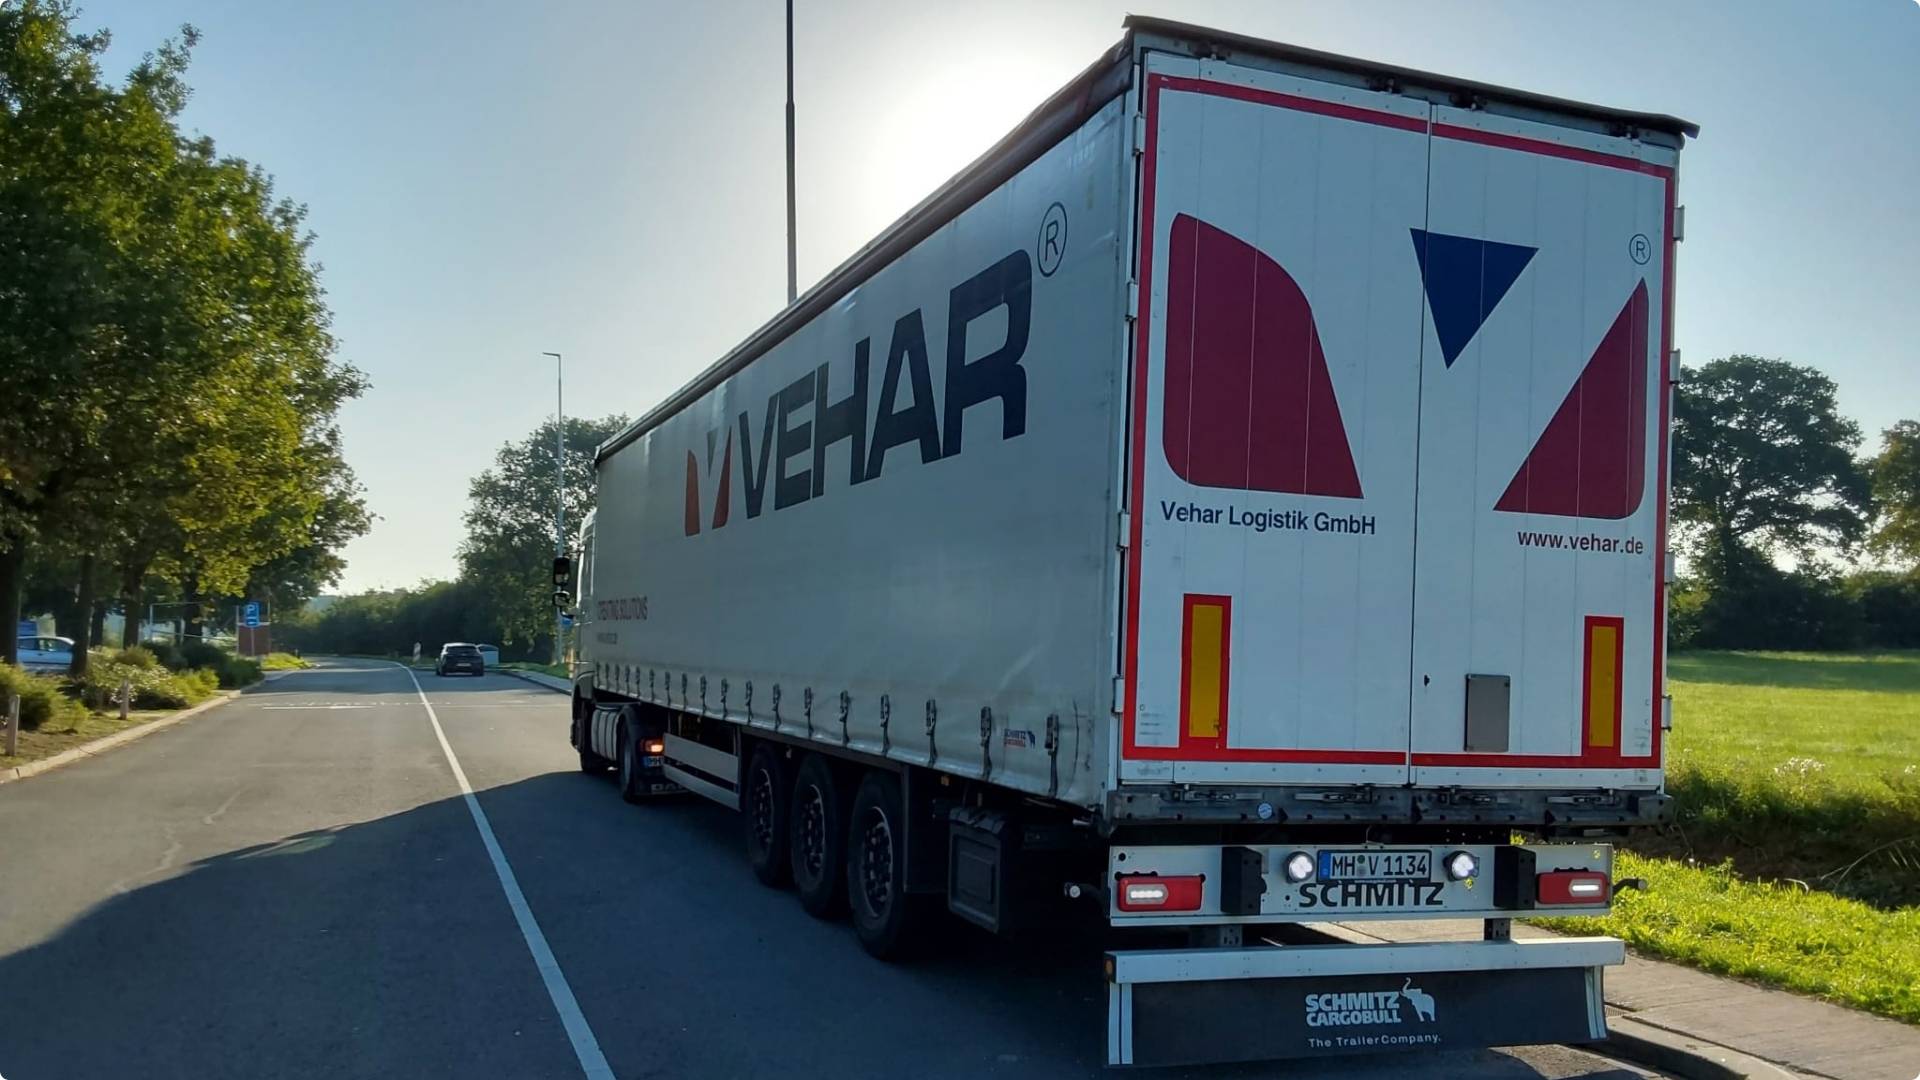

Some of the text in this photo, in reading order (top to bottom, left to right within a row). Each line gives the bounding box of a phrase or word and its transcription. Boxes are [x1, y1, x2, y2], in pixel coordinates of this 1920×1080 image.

[738, 249, 1033, 520] VEHAR
[1161, 500, 1376, 535] Vehar Logistik GmbH
[1517, 531, 1644, 555] www.vehar.de
[247, 604, 256, 615] P
[1331, 855, 1427, 876] MH V 1134
[1299, 881, 1445, 908] SCHMITZ
[1305, 991, 1400, 1012] SCHMITZ
[1306, 1010, 1402, 1027] CARGOBULL
[1308, 1037, 1332, 1048] The
